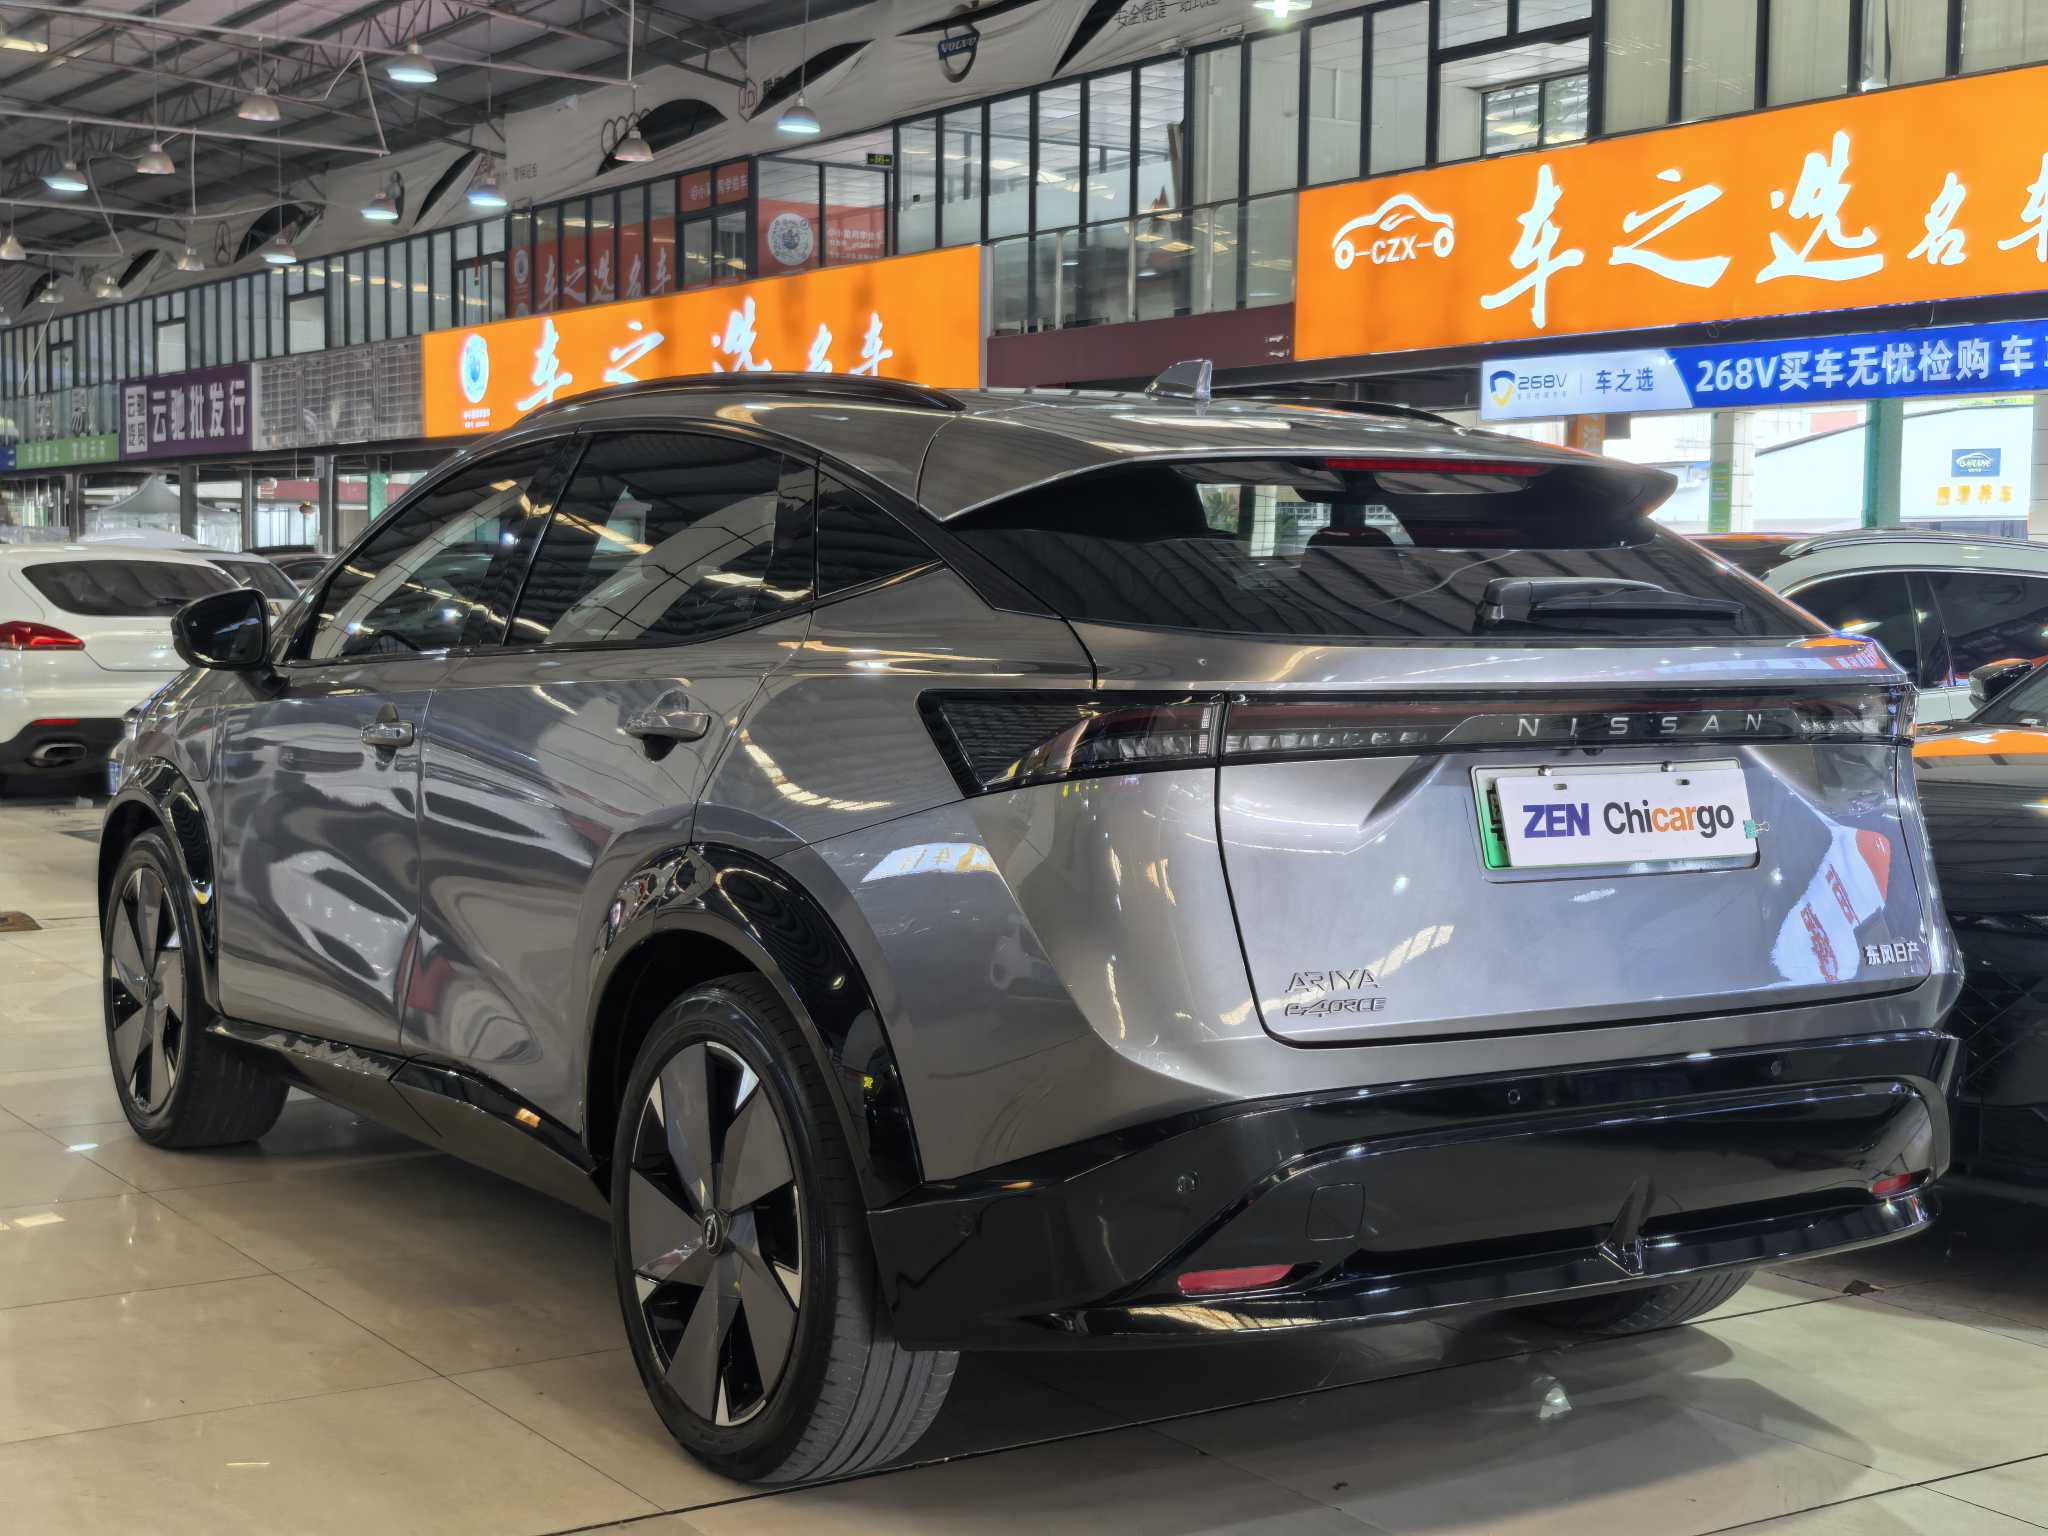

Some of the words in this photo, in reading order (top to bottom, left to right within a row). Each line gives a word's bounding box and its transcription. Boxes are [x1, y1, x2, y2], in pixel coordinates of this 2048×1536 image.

[1371, 235, 1417, 264] CZX
[1518, 374, 1567, 390] 268V
[1596, 367, 1654, 394] 车之选
[1517, 714, 1762, 737] NISSAN
[1523, 803, 1591, 838] ZEN
[1603, 800, 1735, 839] Chicargo
[1864, 941, 1920, 965] 东风日产
[1284, 968, 1384, 993] ARIYA
